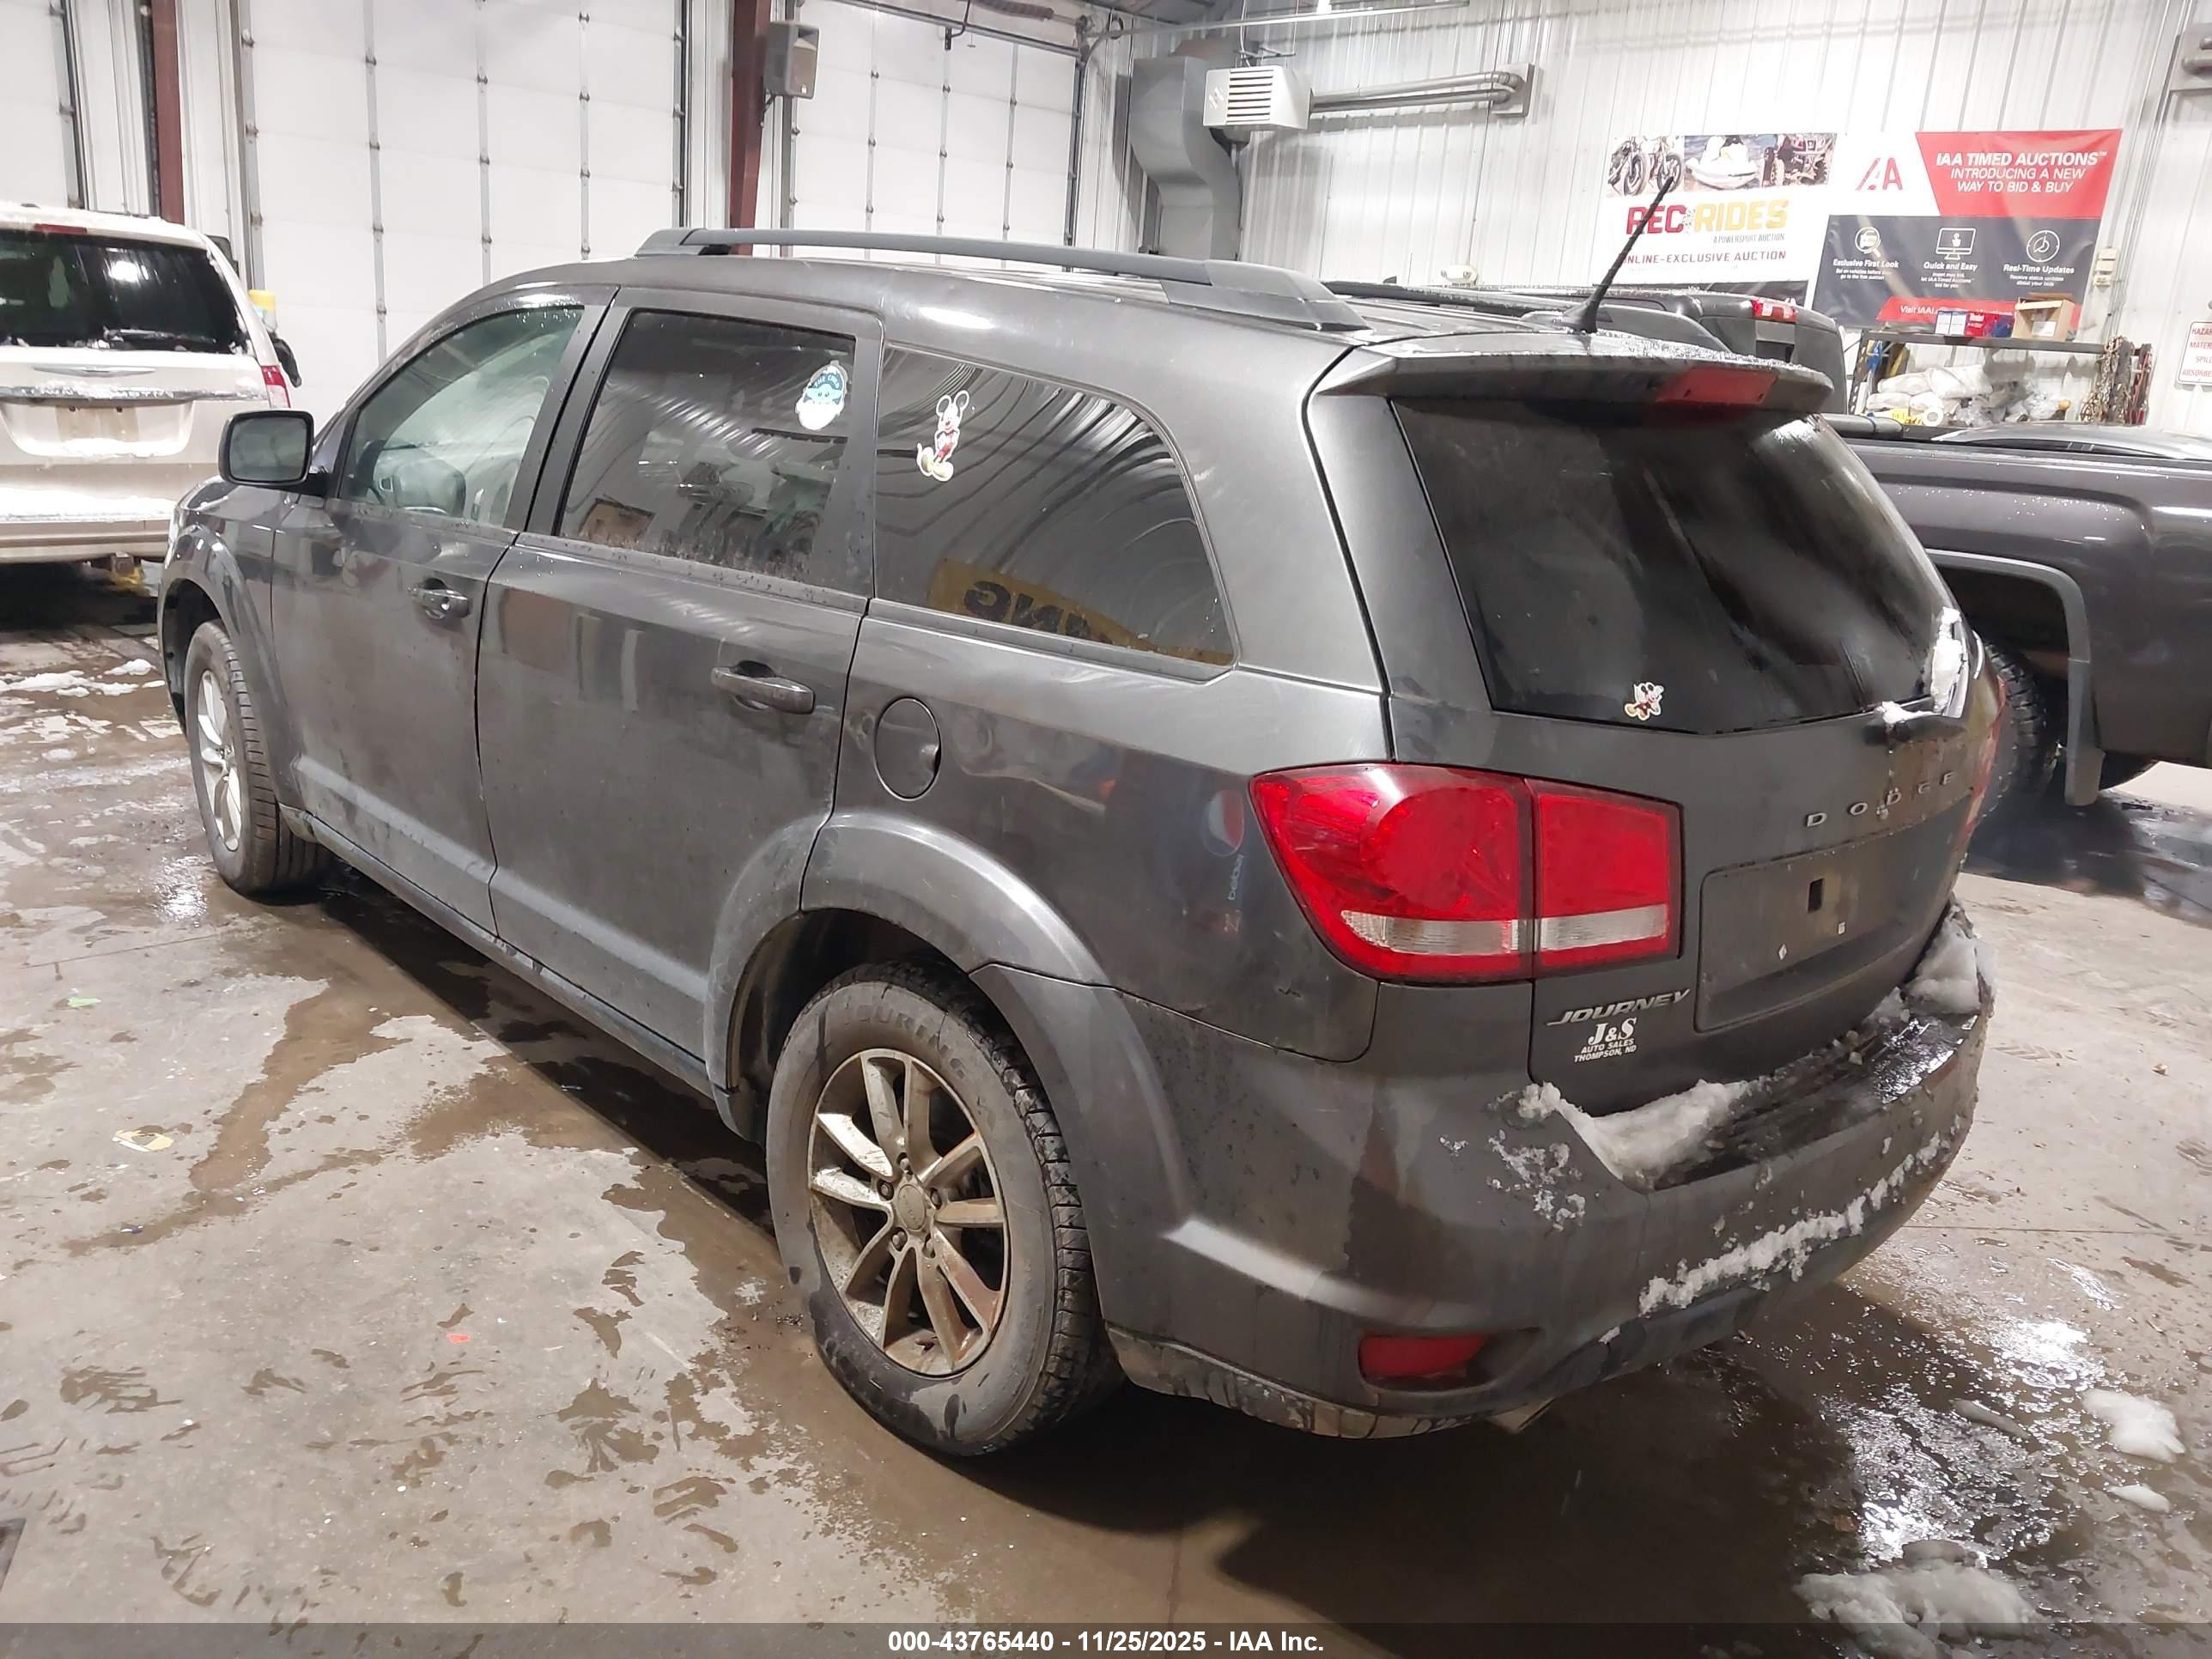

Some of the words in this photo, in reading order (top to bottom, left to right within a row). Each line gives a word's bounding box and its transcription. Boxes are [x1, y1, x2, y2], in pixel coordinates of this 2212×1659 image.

[1936, 152, 1963, 167] IAA
[1966, 152, 2013, 166] TIMED
[1950, 167, 2037, 179] INTRODUCING
[2039, 168, 2049, 179] A
[2053, 168, 2086, 179] NEW
[1957, 181, 1984, 192] WAY
[1987, 181, 2003, 192] TO
[2007, 180, 2028, 193] BID
[2031, 180, 2042, 193] &
[2045, 181, 2074, 193] BUY
[1626, 205, 1686, 234] REC
[1693, 199, 1789, 232] RIDES
[1759, 233, 1785, 241] AUCTION
[1734, 251, 1786, 261] AUCTION
[1832, 258, 1863, 267] Exclusive
[1864, 259, 1880, 268] First
[1923, 261, 1945, 270] Quick
[1960, 263, 1978, 271] Easy
[2003, 264, 2041, 273] Real-Time
[2042, 265, 2075, 274] Updates
[1807, 771, 1955, 827] DODGE
[1547, 988, 1691, 1026] JOURNEY
[1588, 1017, 1638, 1045] J&S
[1581, 1043, 1606, 1054] AUTO
[1607, 1037, 1635, 1050] SALES
[1574, 1048, 1623, 1063] THOMPSON,
[1625, 1044, 1638, 1054] ND
